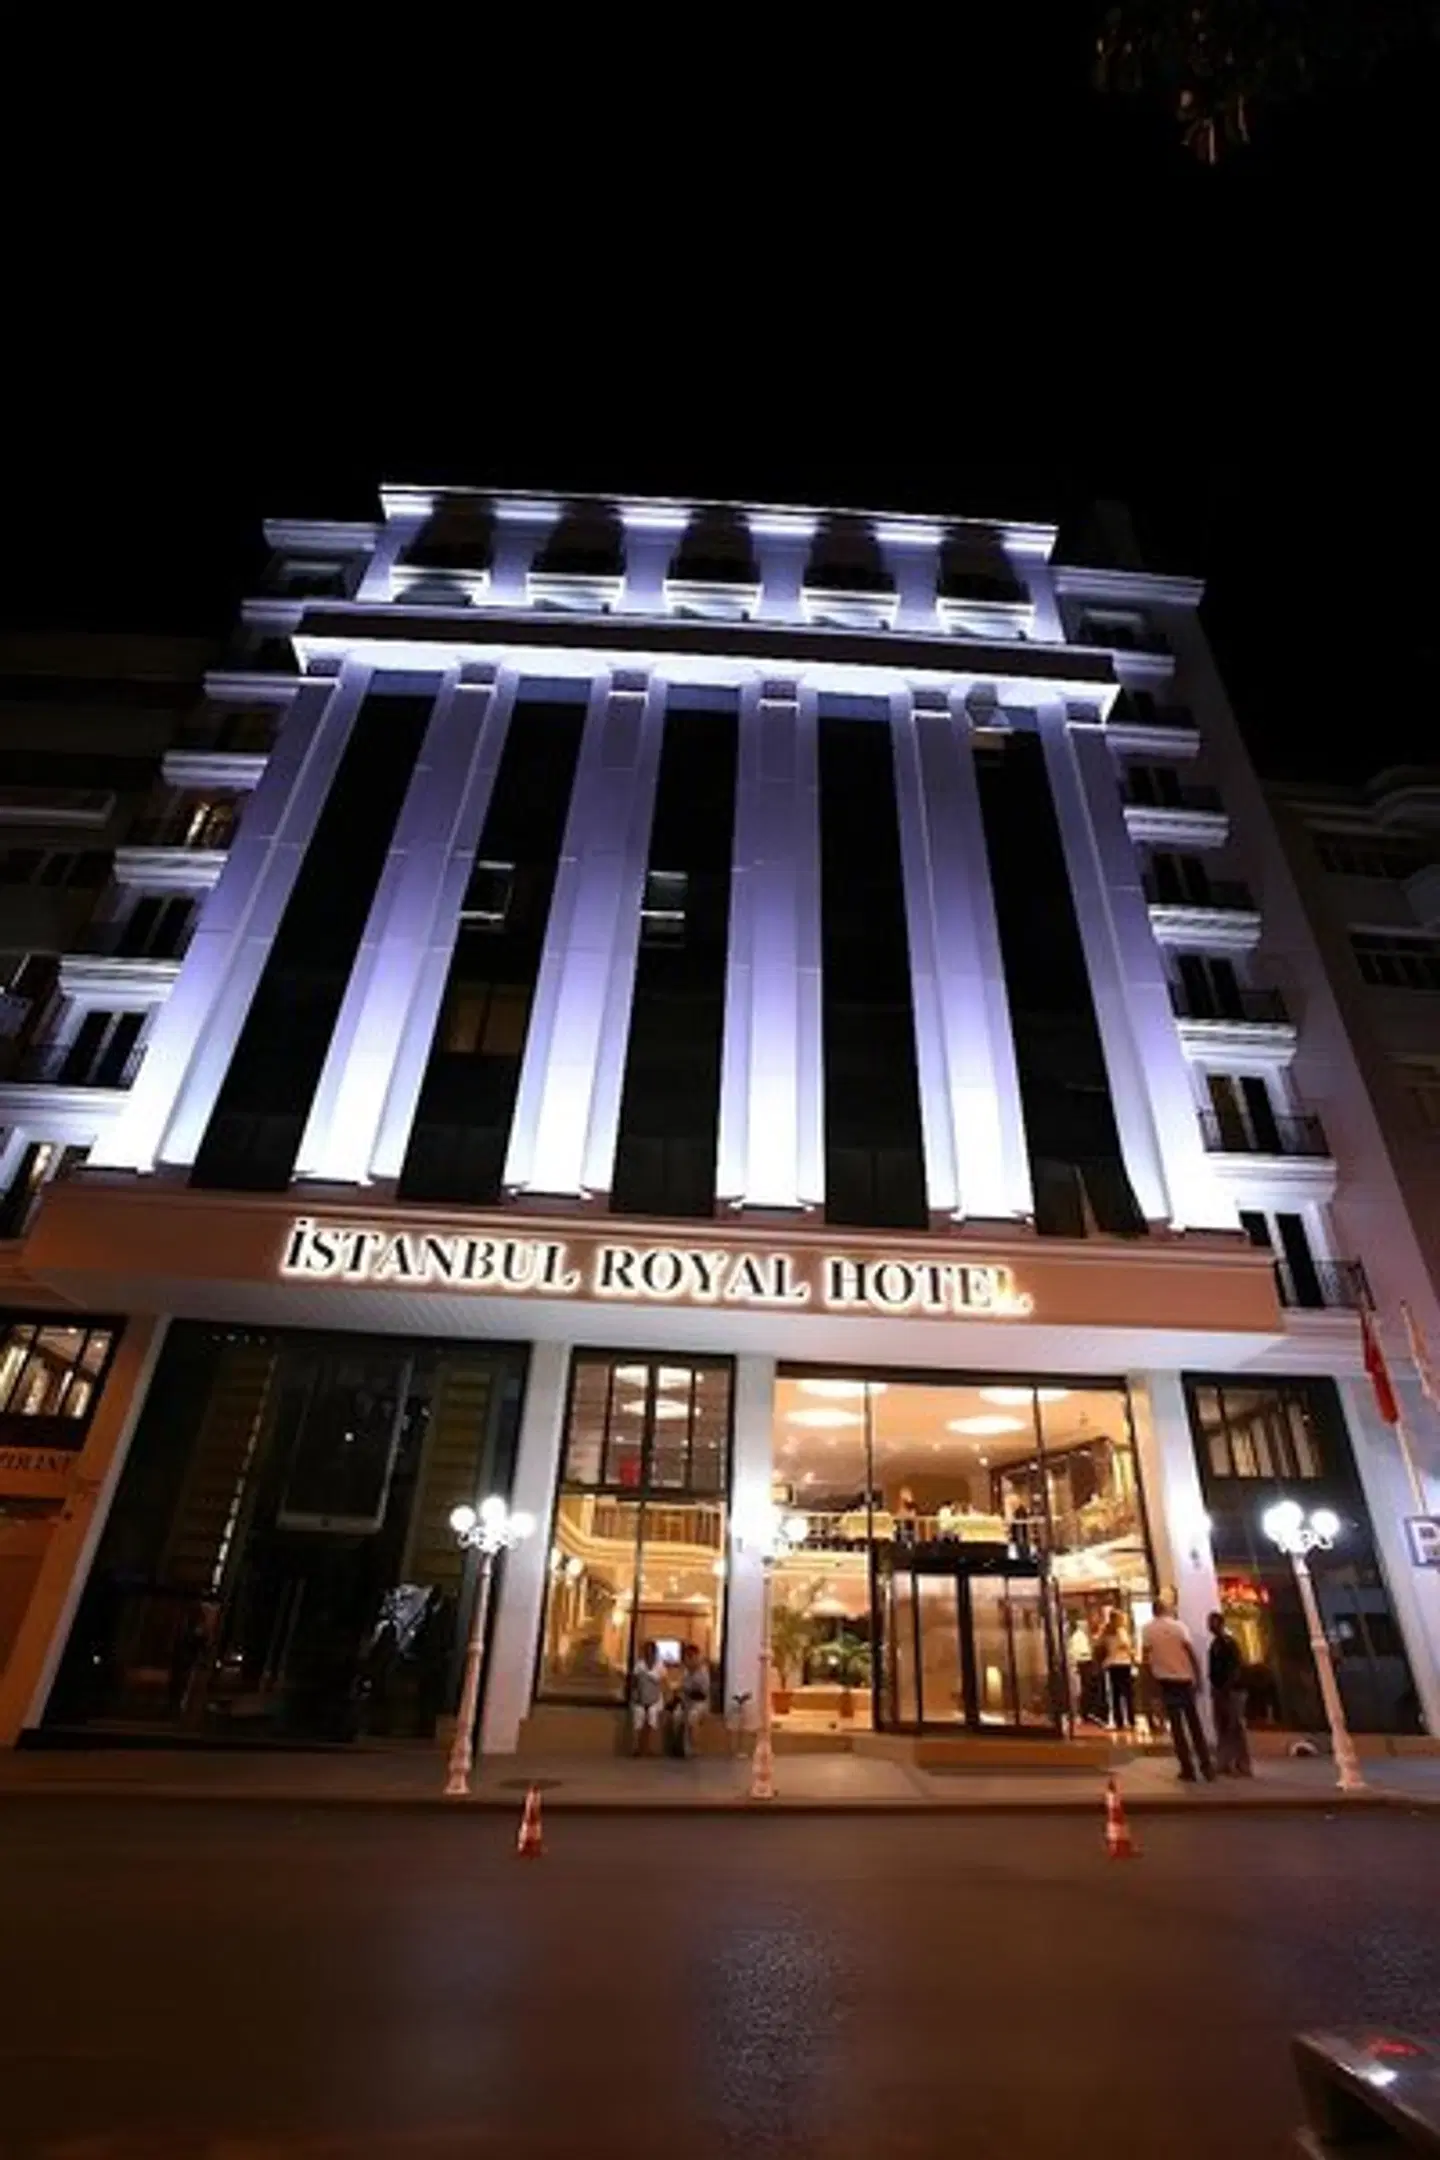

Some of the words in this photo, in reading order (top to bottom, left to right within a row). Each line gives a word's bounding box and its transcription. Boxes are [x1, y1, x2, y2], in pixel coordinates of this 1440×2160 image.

[284, 1218, 577, 1288] İSTANBUL
[599, 1247, 809, 1300] ROYAL
[829, 1259, 1030, 1311] HOTEL
